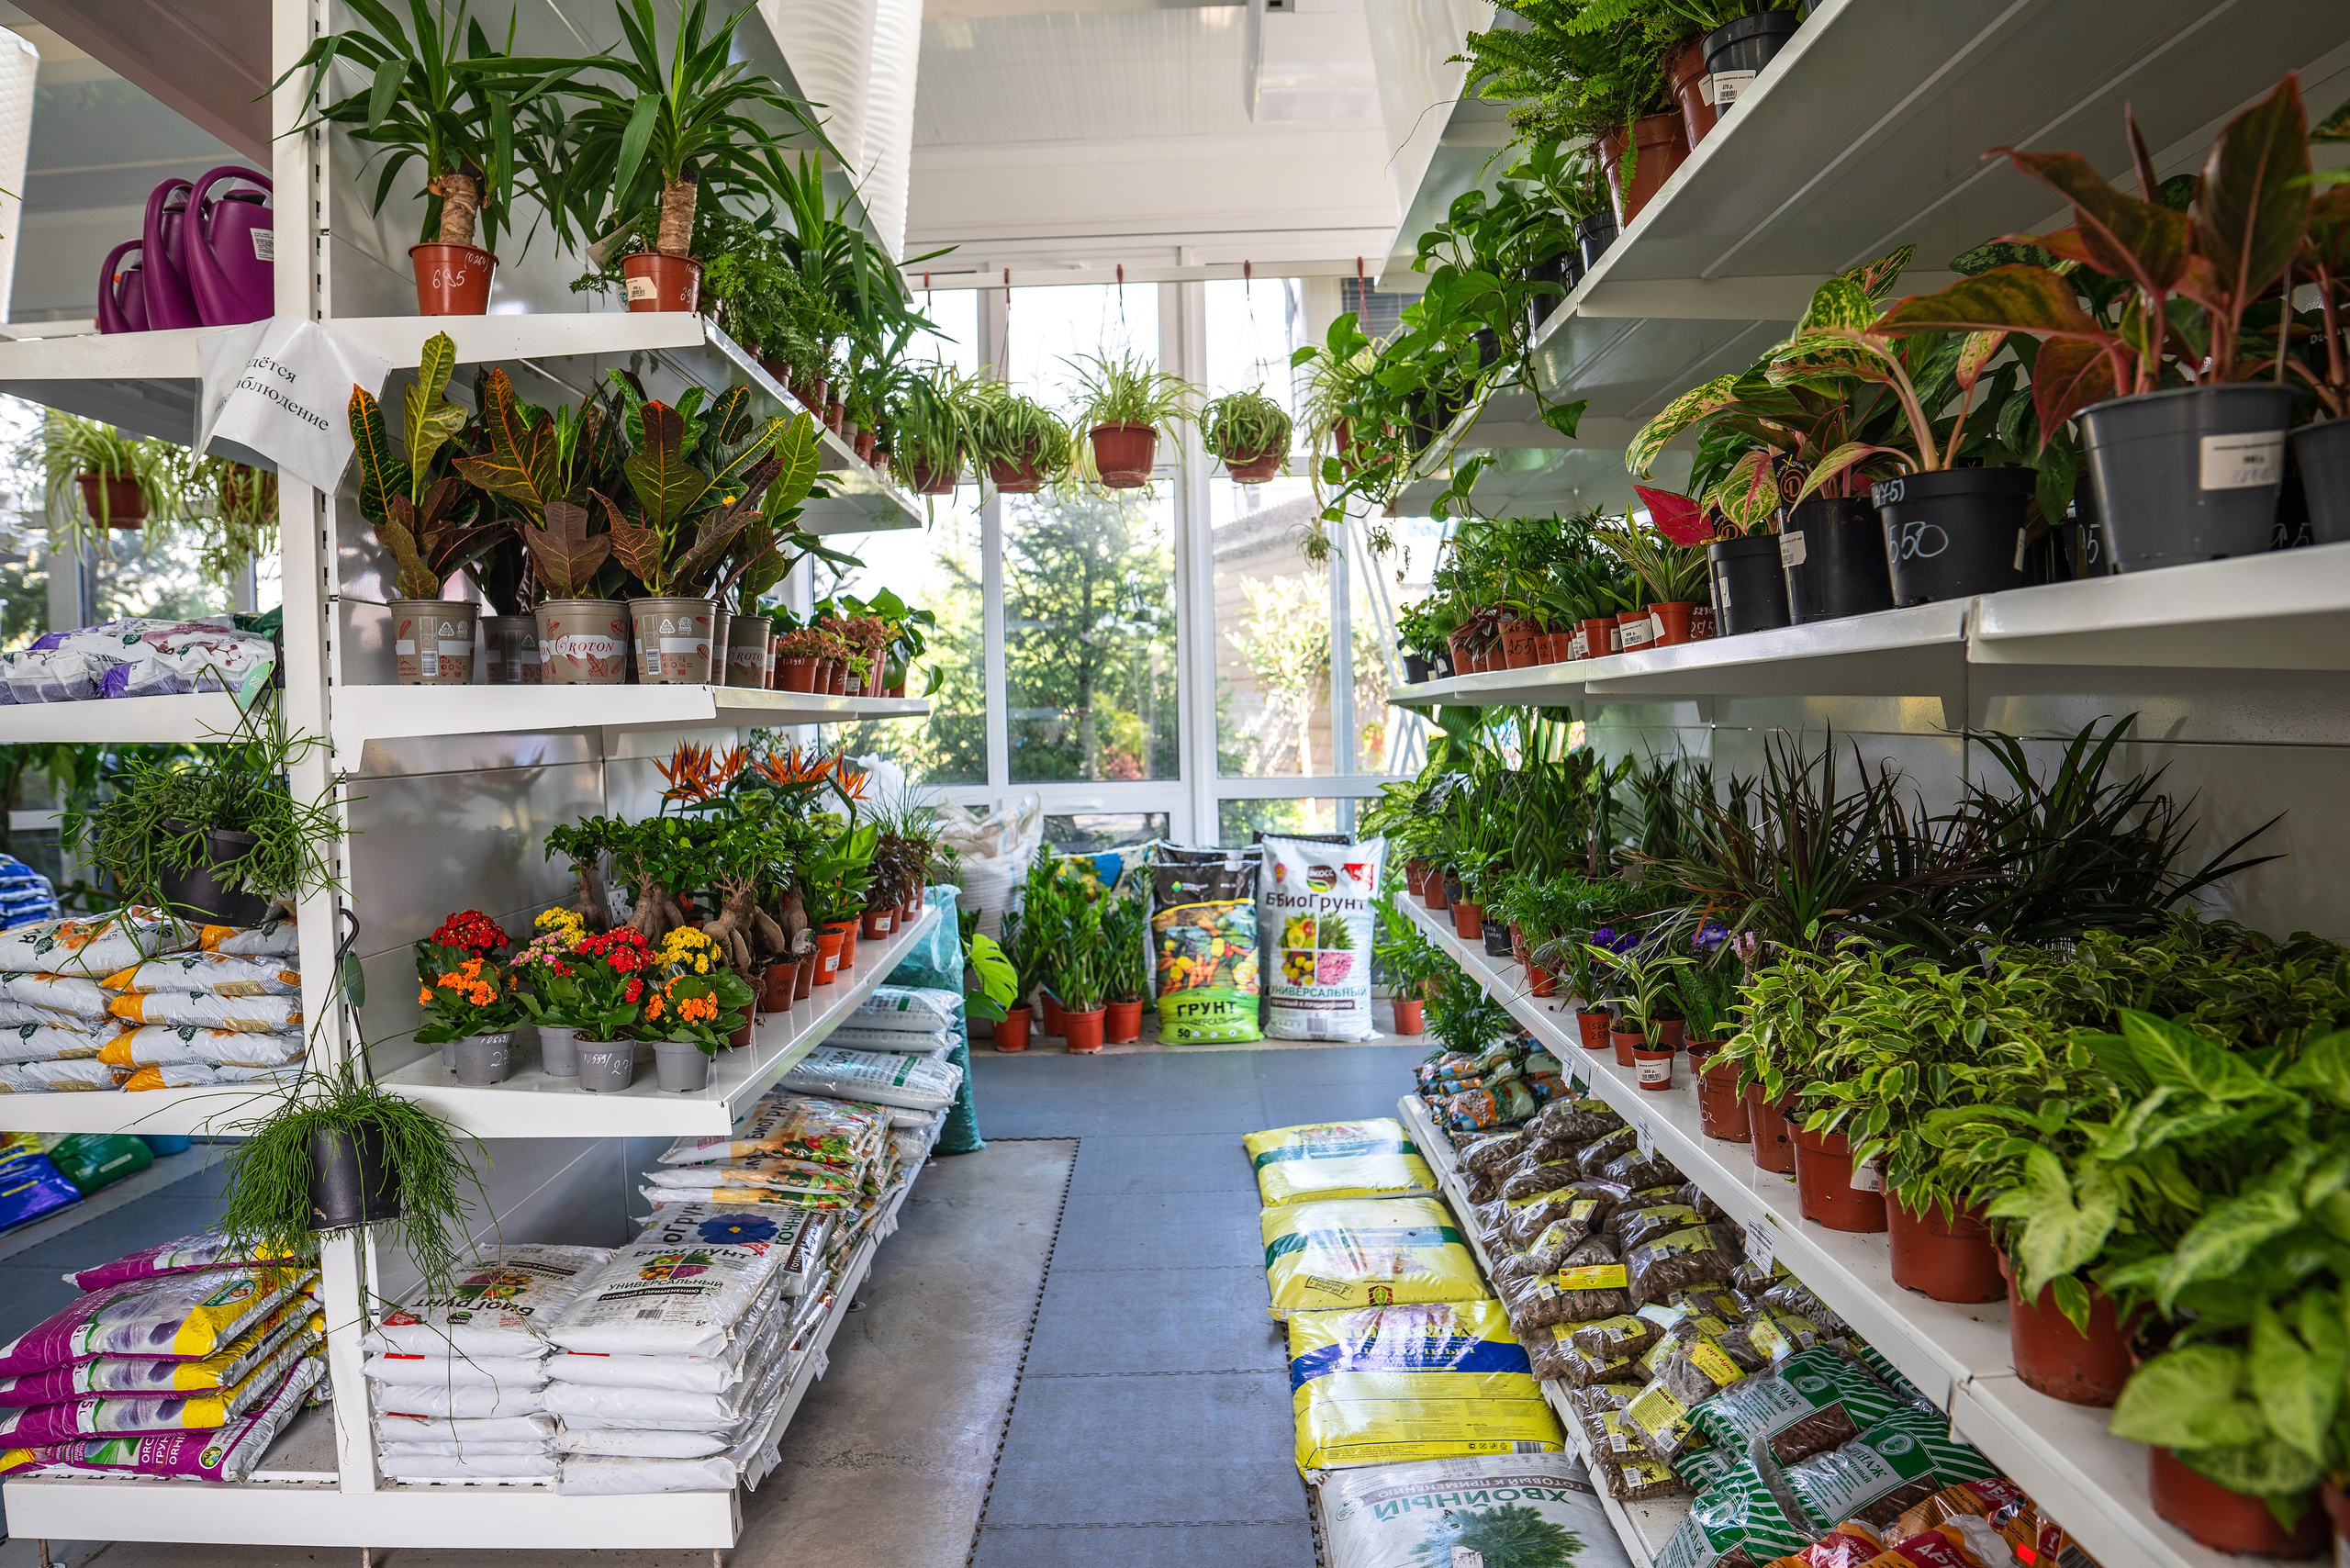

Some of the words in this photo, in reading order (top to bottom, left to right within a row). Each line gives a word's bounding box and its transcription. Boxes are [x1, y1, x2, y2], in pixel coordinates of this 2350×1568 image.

[247, 356, 297, 385] дётся
[555, 633, 615, 655] CROTON
[1507, 637, 1533, 656] 255
[1270, 985, 1368, 998] УНИВЕРСАЛЬНЫЙ
[1177, 1001, 1237, 1017] ГРУНТ
[1177, 1028, 1191, 1038] 50
[633, 1247, 753, 1260] БиоГрунт
[609, 1278, 723, 1291] УНИВЕРСАЛЬНЫЙ
[600, 1290, 638, 1301] ГОТОВЫЙ
[644, 1287, 700, 1295] ПРИМЕНЕНИЮ
[410, 1297, 535, 1317] БиоГрунт
[1377, 1479, 1491, 1498] ПРИМЕНЕНИЮ
[1492, 1478, 1501, 1486] К
[1506, 1476, 1583, 1492] ГОТОВЫЙ
[1373, 1486, 1572, 1522] ХВОЙНЫЙ
